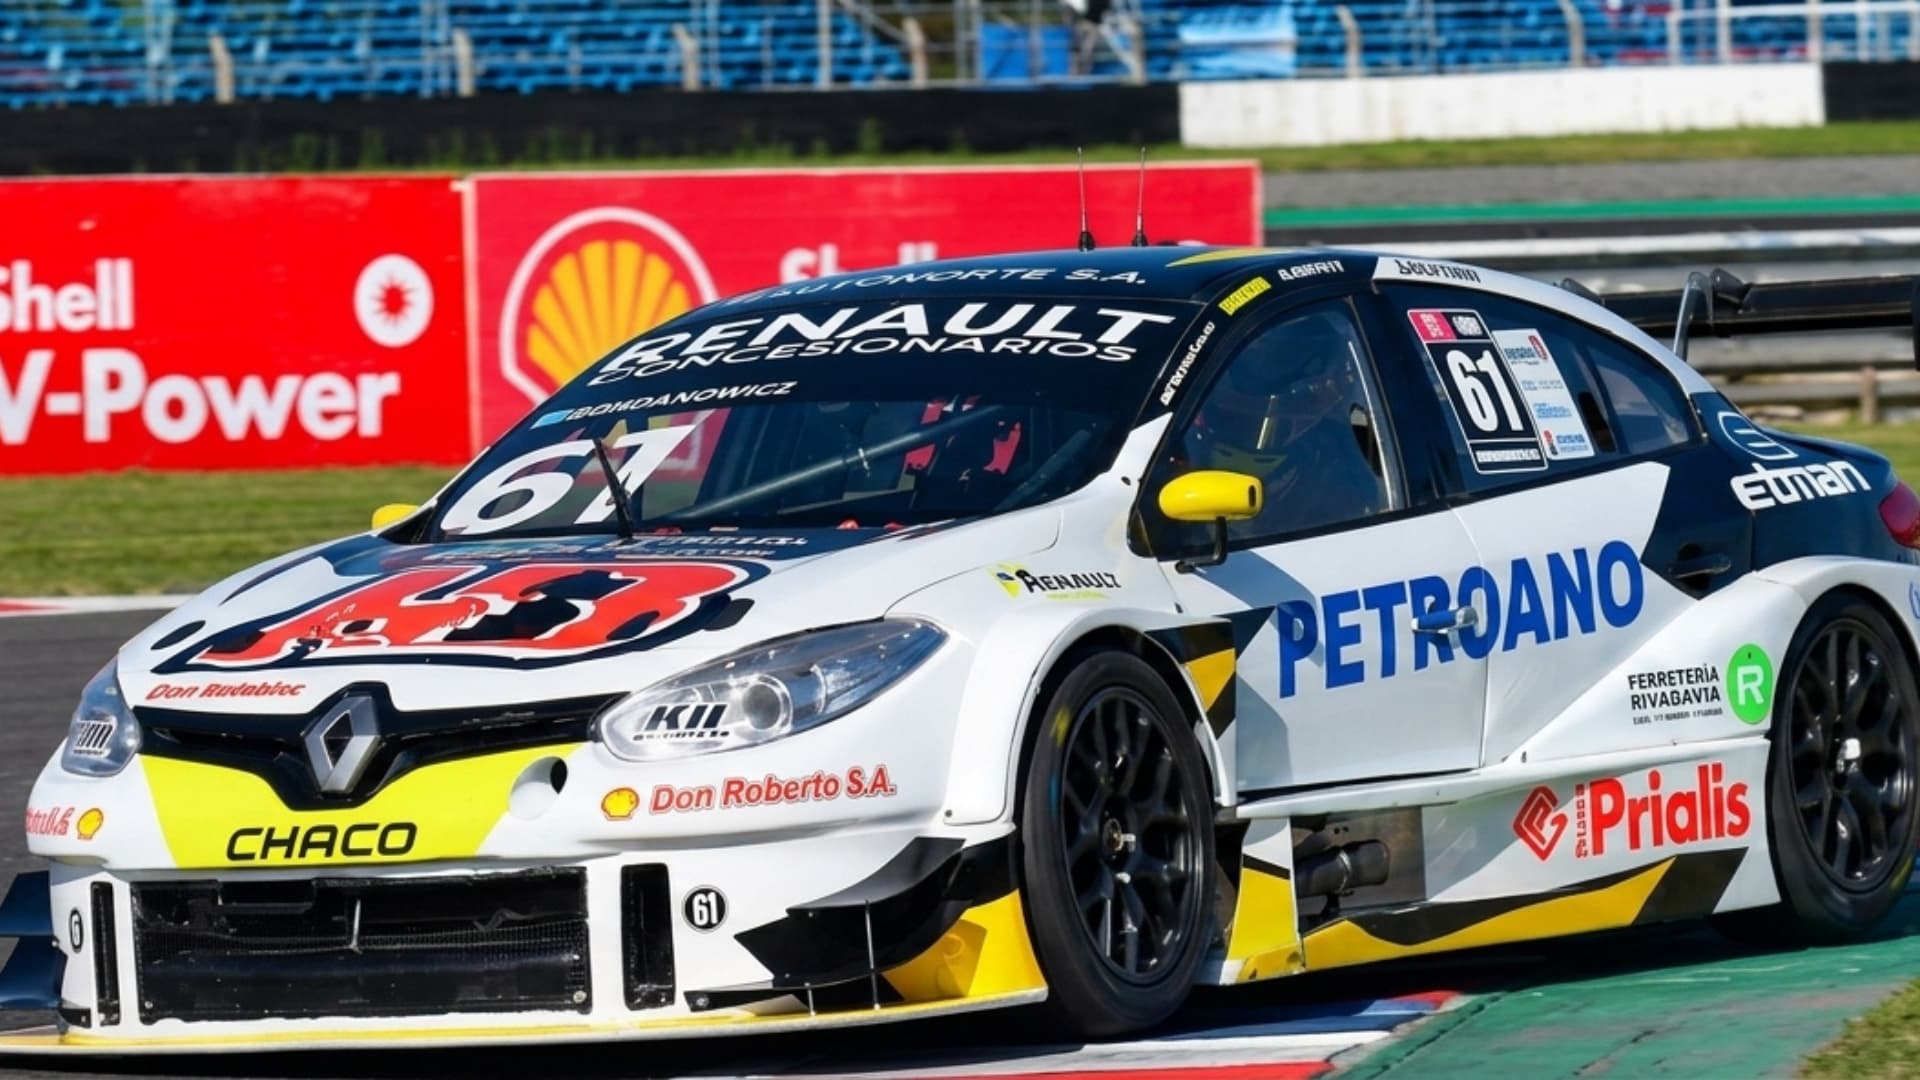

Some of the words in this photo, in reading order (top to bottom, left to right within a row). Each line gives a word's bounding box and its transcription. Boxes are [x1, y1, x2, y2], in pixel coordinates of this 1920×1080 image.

[586, 337, 1138, 387] CONCESIONARIOS
[600, 303, 1176, 374] RENAULT
[1447, 350, 1525, 432] 61
[1730, 460, 1872, 510] etman
[1275, 540, 1644, 699] PETROANO
[1736, 664, 1764, 706] R
[651, 786, 713, 813] Don
[723, 773, 839, 805] Roberto
[847, 765, 896, 796] S.A.
[1590, 762, 1750, 856] Prialis
[227, 822, 418, 861] CHACO
[691, 892, 719, 926] 61
